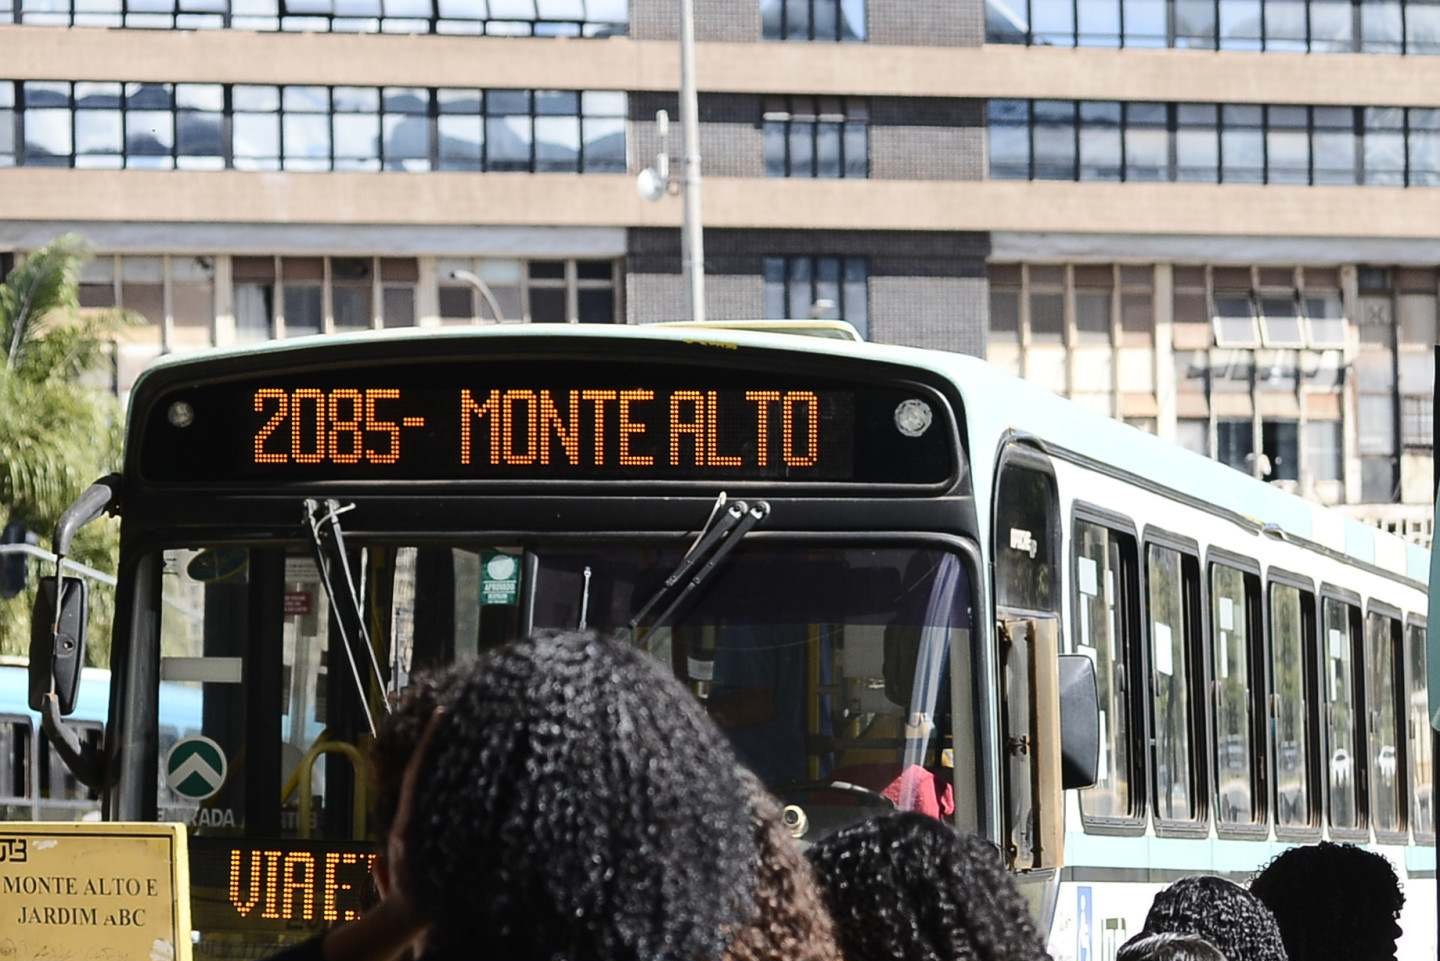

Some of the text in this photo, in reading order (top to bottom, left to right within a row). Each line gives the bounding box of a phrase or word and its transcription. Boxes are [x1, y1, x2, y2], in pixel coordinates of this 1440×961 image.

[461, 389, 654, 465] MONTE
[670, 390, 818, 466] ALTO
[3, 876, 158, 897] MONTE ALTO E
[18, 907, 146, 927] JARDIM ABC
